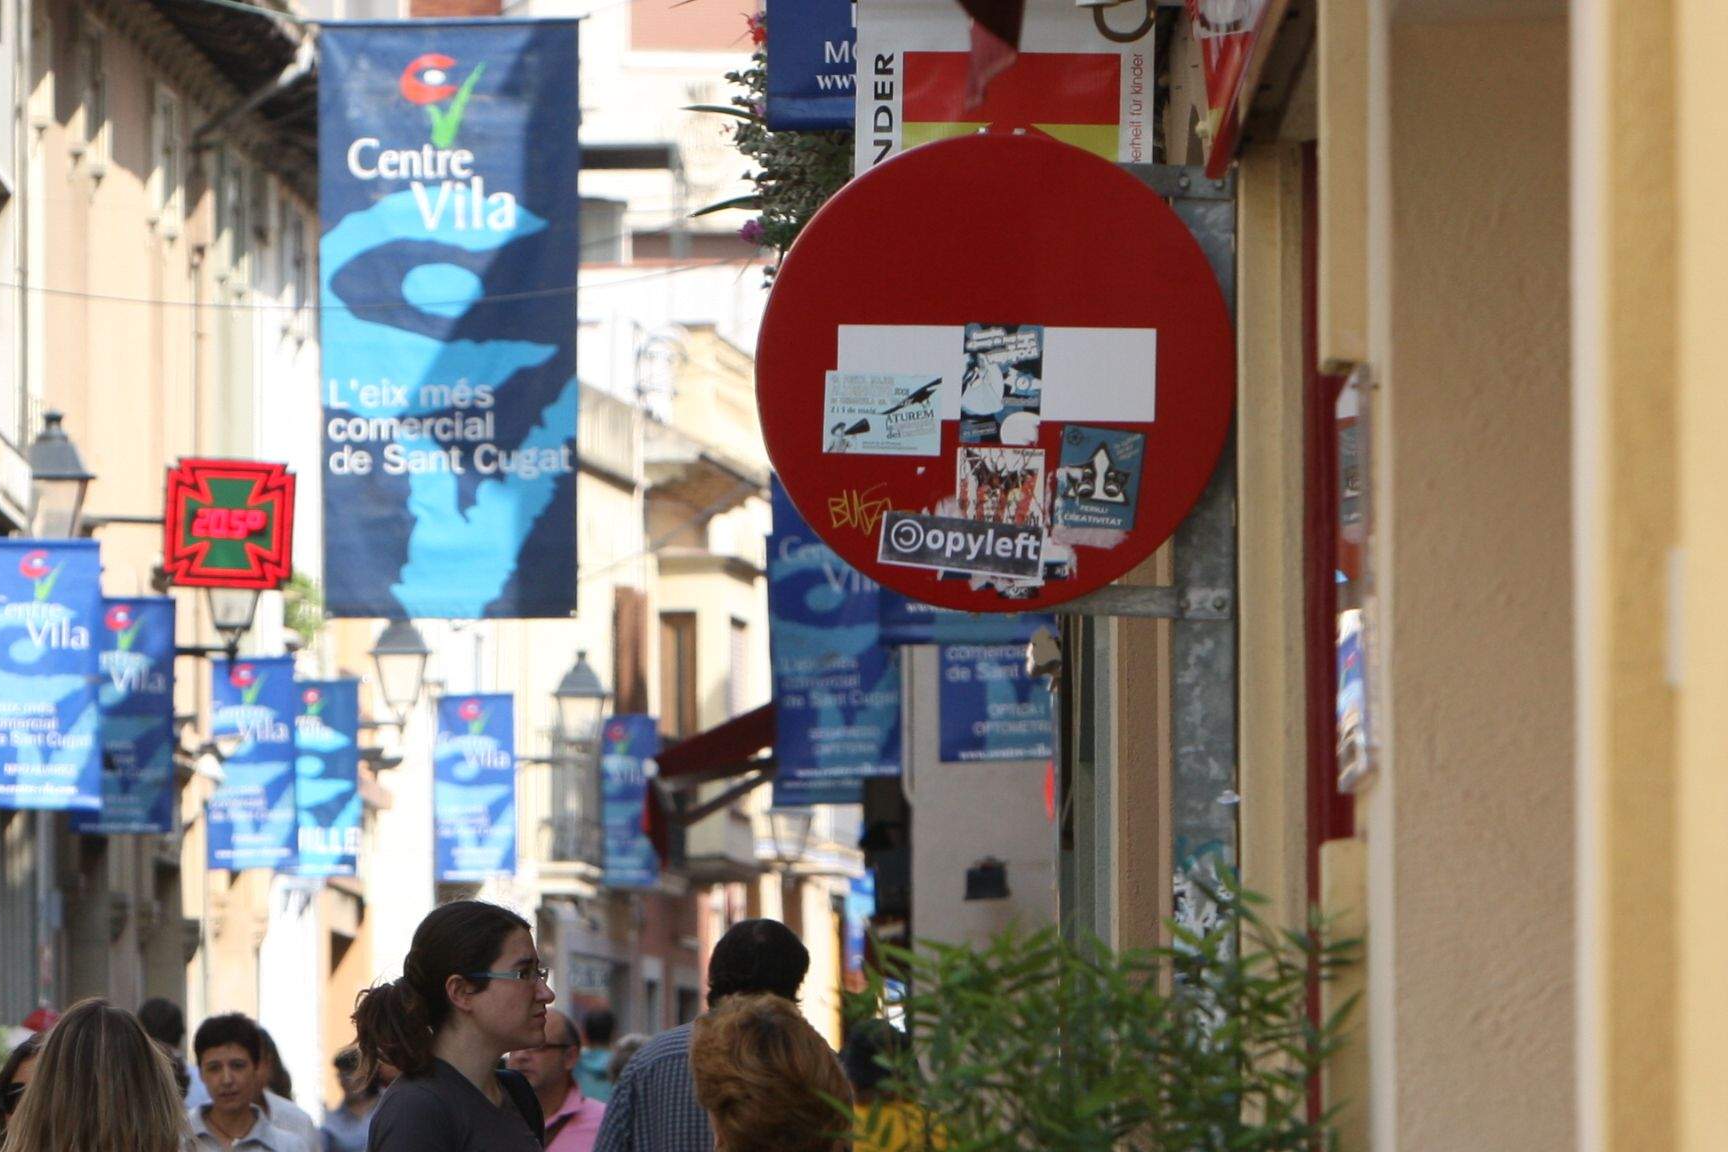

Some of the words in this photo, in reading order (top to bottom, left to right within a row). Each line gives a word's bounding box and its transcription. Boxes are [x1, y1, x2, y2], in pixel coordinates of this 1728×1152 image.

[1131, 53, 1144, 94] kinder
[1131, 96, 1143, 117] für
[347, 137, 474, 180] Centre
[410, 175, 516, 231] Vila
[328, 378, 410, 409] L'eix
[420, 377, 495, 408] més
[328, 411, 495, 442] comercial
[329, 446, 372, 475] de
[383, 444, 465, 475] Sant
[473, 443, 572, 480] Cugat
[26, 616, 90, 650] Vila
